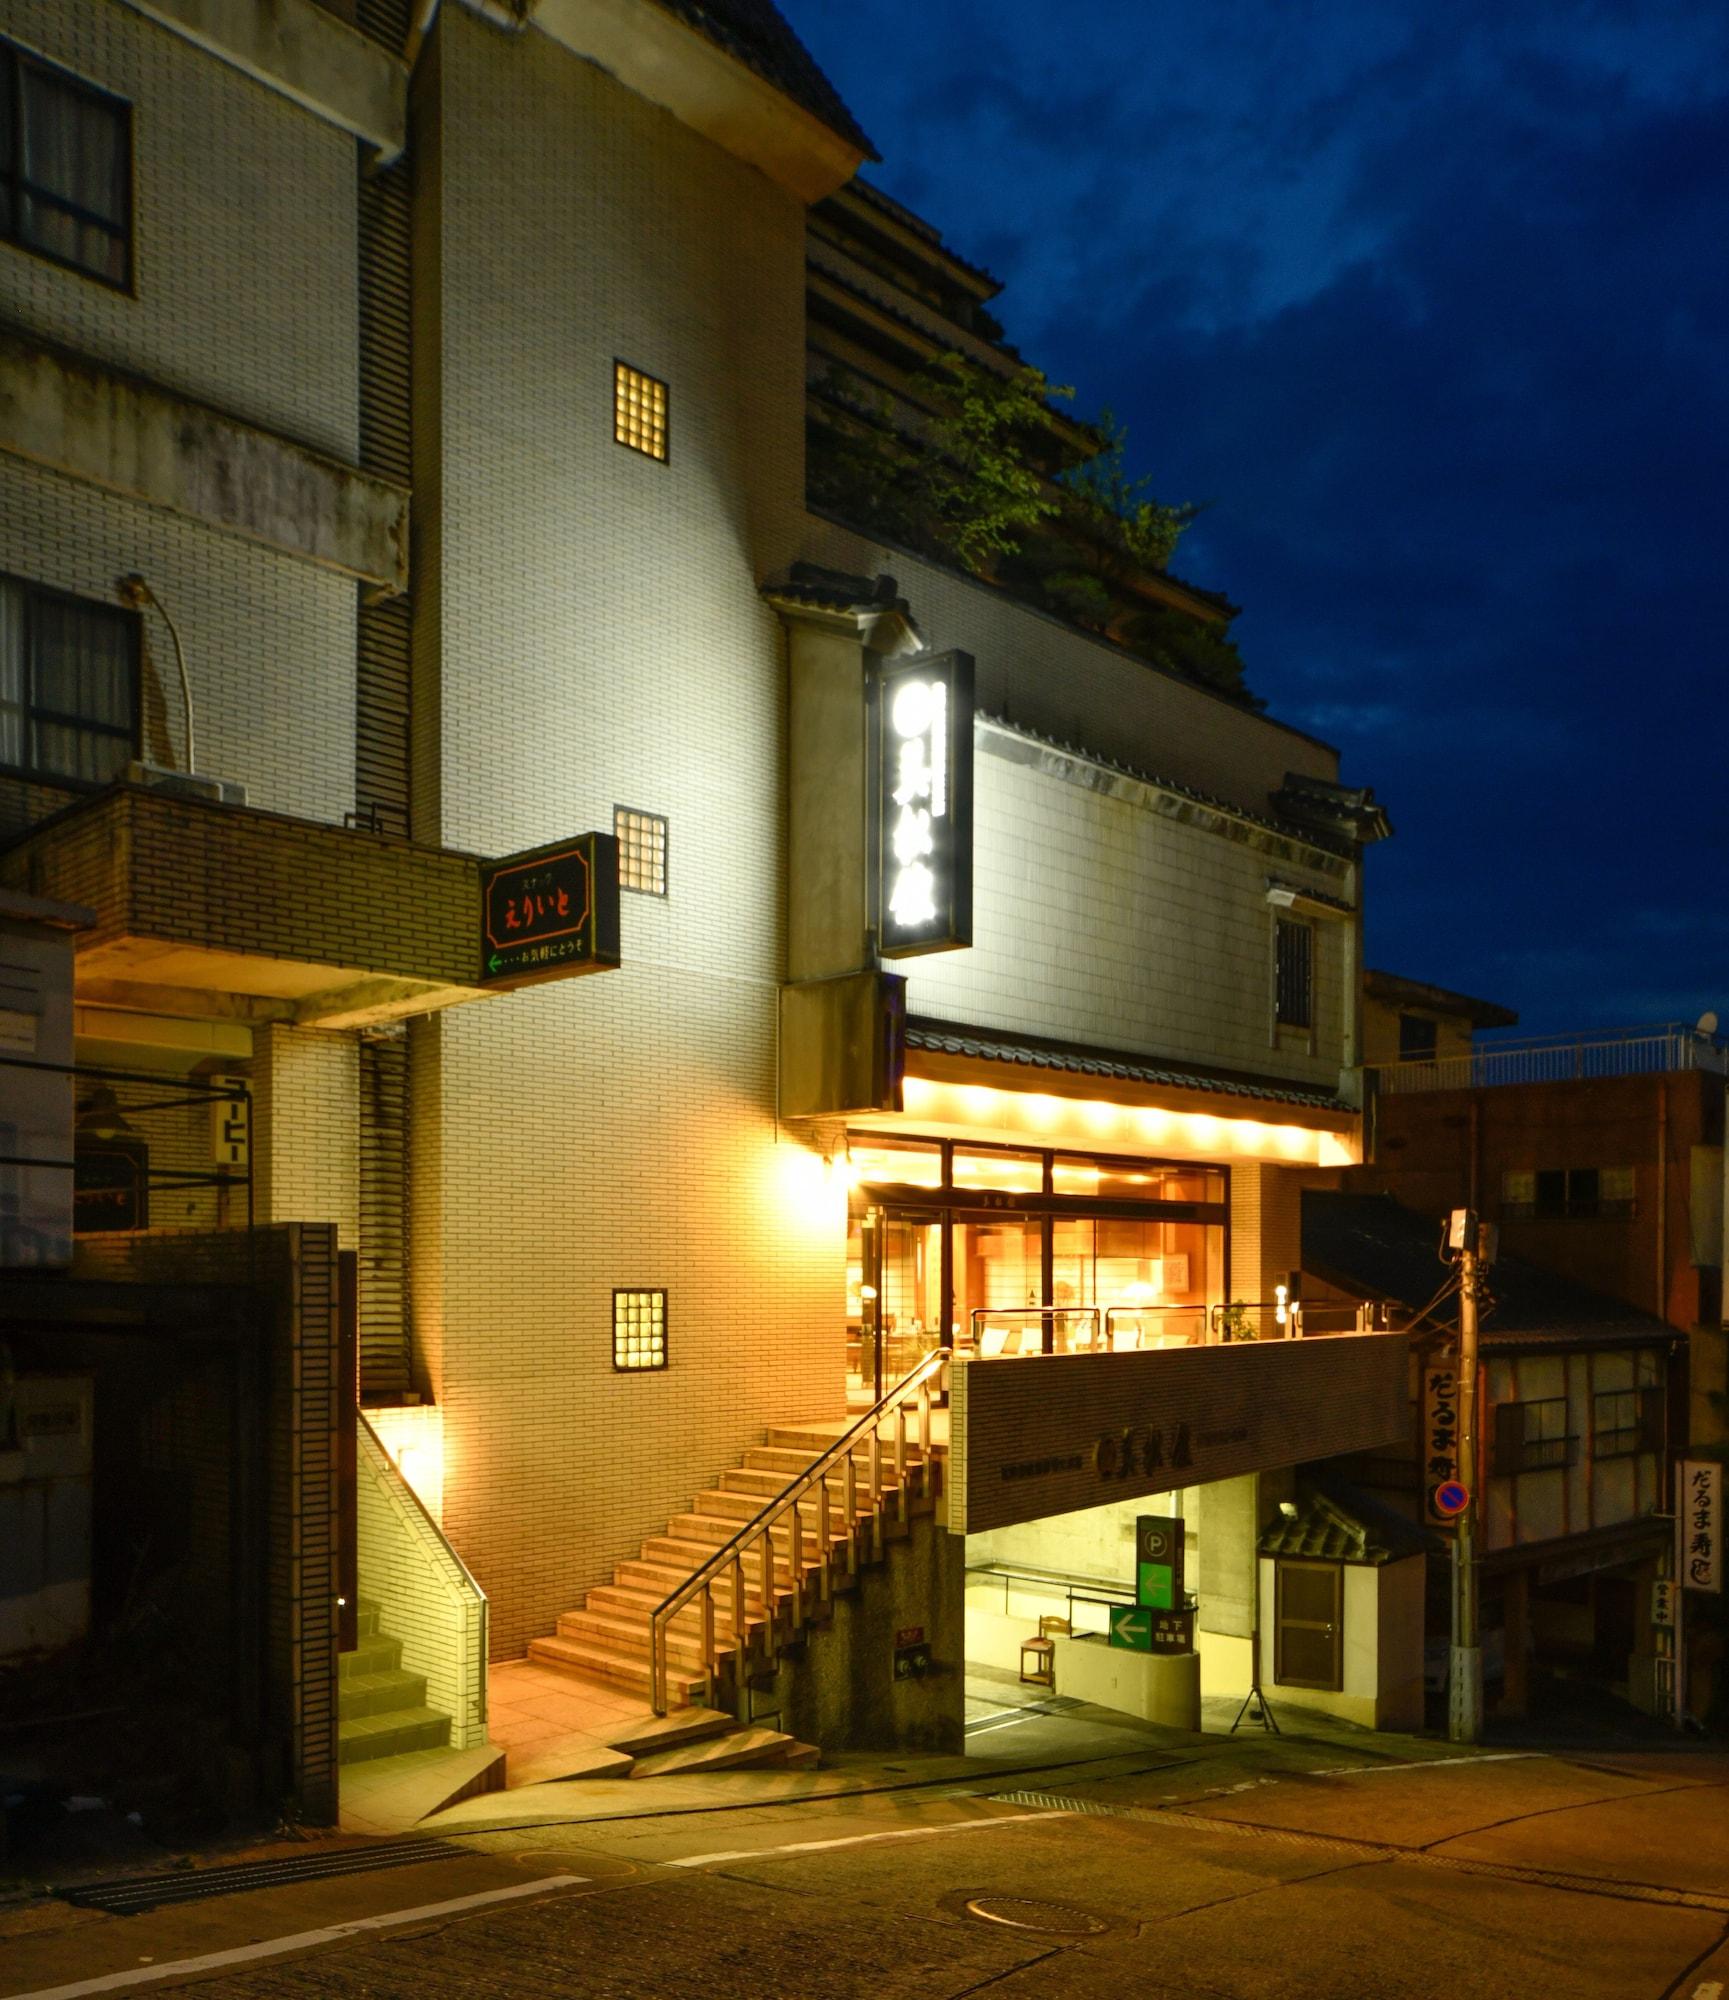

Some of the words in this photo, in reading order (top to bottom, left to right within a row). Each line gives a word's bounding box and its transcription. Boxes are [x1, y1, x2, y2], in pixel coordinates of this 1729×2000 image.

[505, 888, 570, 929] えりいと
[1689, 1470, 1712, 1586] だるま寿し
